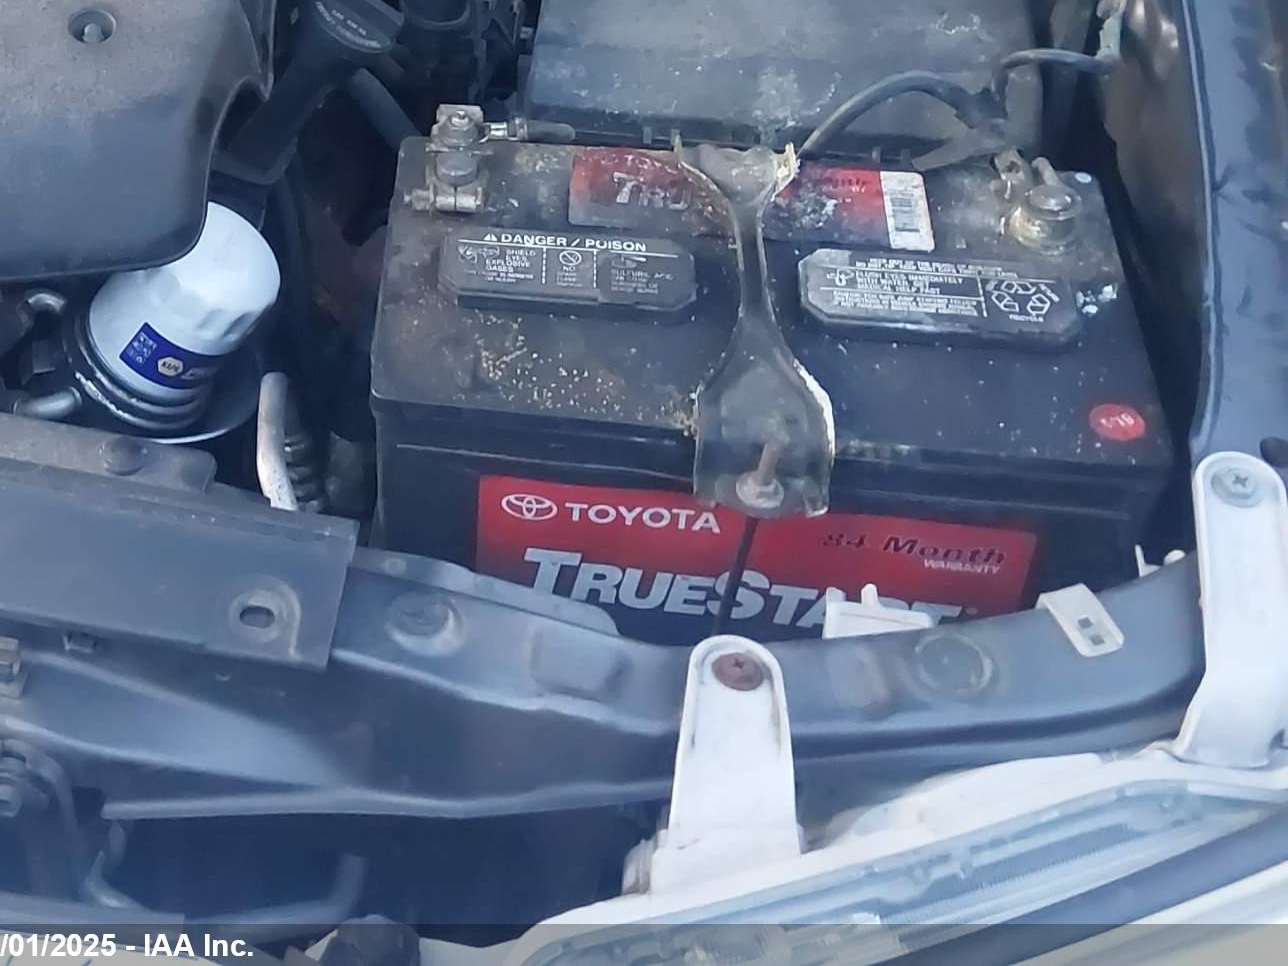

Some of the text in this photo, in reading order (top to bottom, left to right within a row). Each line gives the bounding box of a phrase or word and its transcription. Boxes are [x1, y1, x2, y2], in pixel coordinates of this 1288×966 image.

[501, 233, 567, 247] DANGER
[585, 238, 647, 252] POISON
[908, 274, 964, 284] IMMEDIATELY
[564, 502, 721, 534] TOYOTA
[883, 536, 1005, 564] Month
